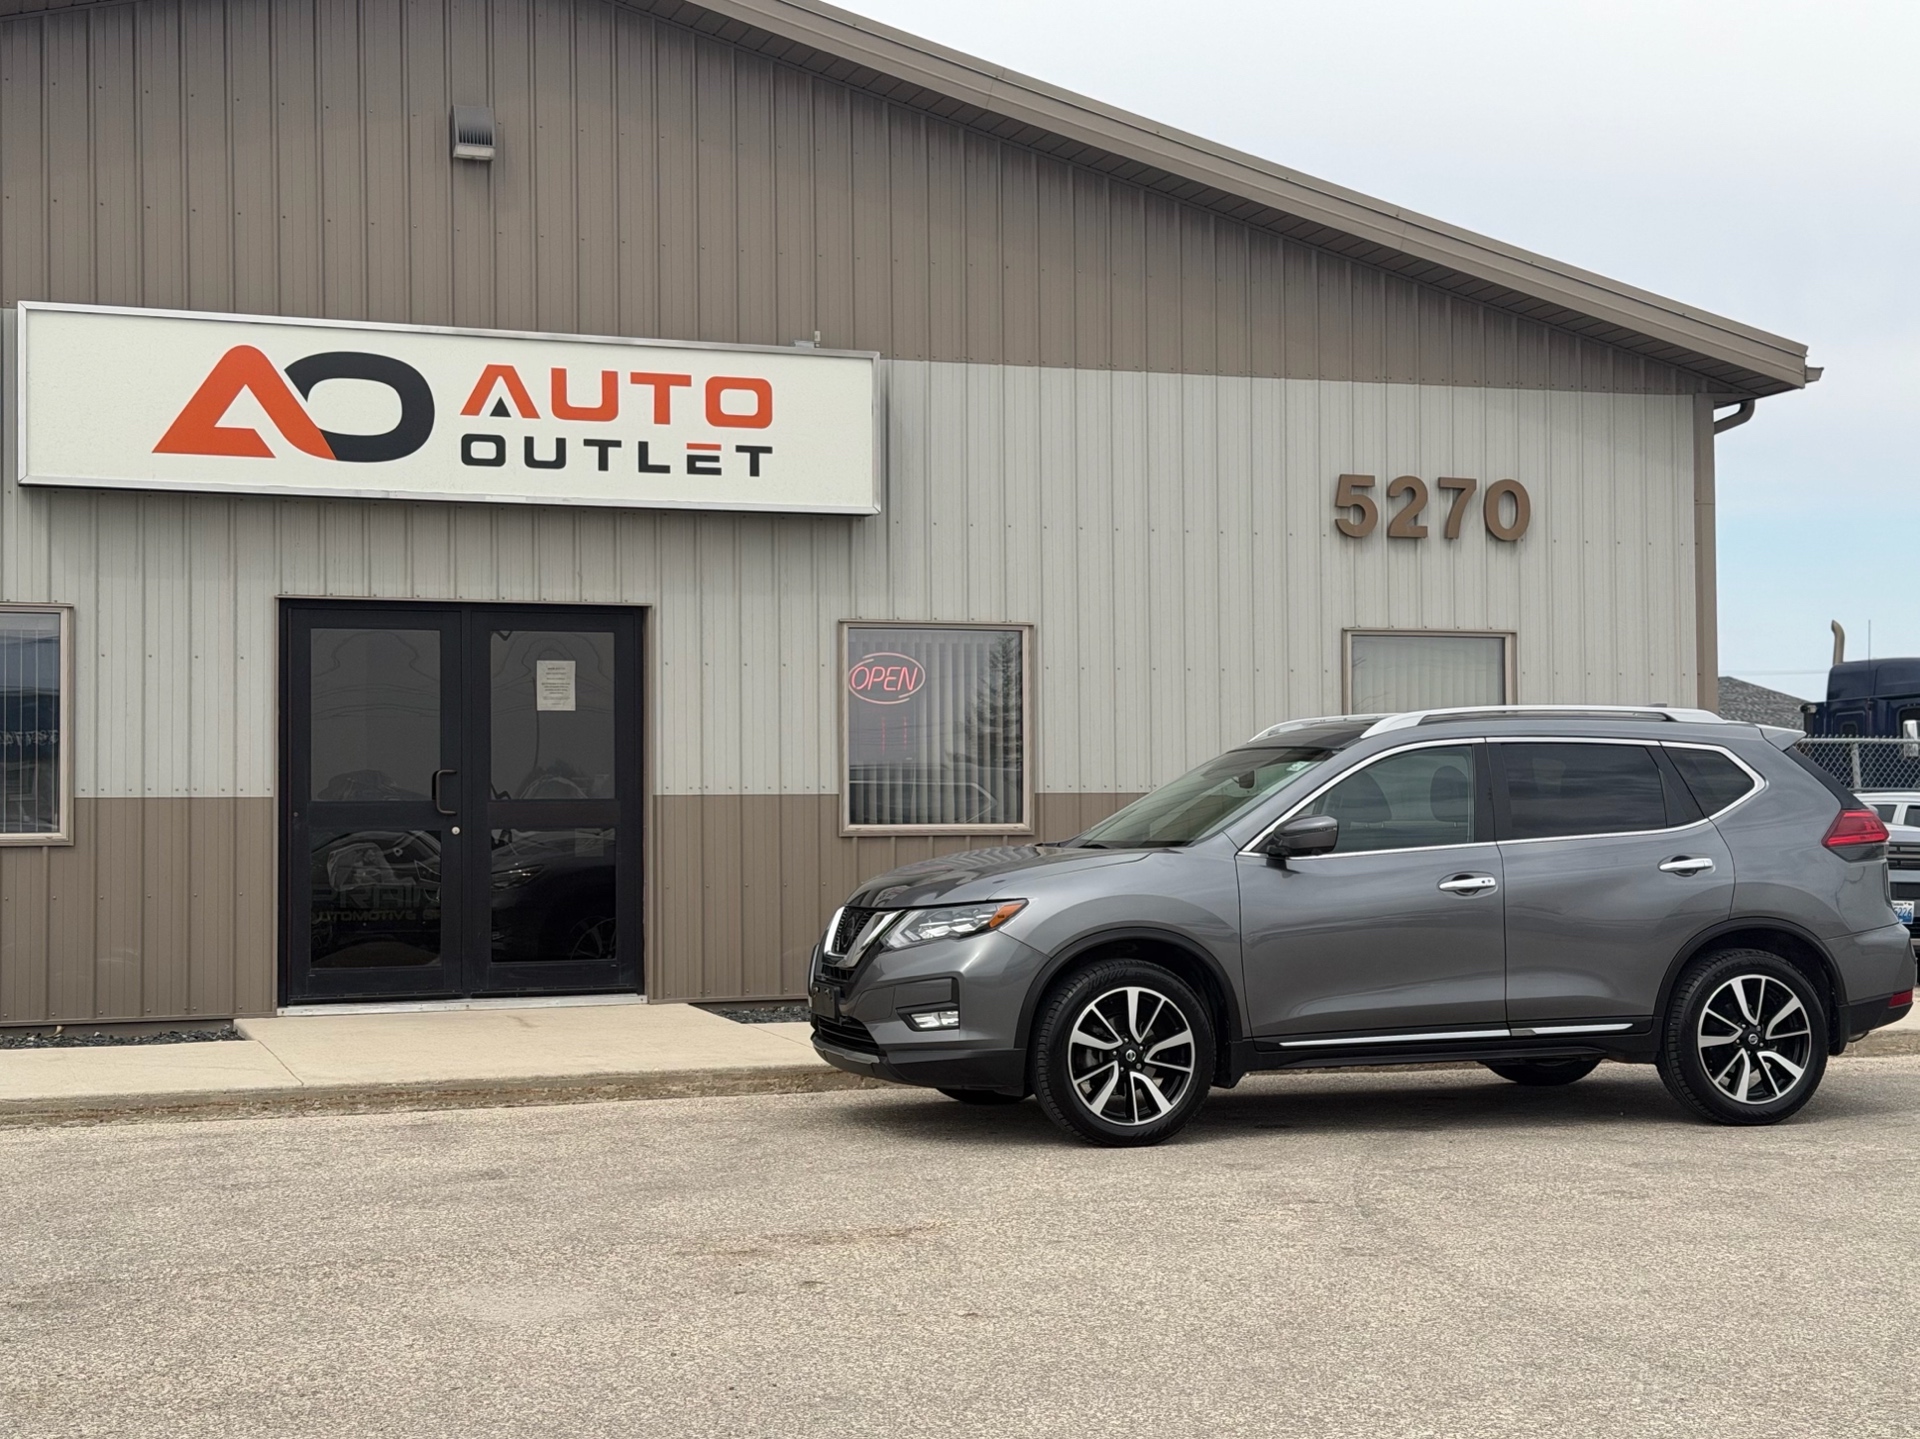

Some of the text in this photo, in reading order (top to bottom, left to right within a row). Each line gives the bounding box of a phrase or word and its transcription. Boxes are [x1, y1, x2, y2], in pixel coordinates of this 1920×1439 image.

[153, 345, 435, 462] AO
[461, 363, 774, 429] AUTO
[461, 433, 774, 477] OUTLET
[1335, 474, 1531, 541] 5270
[851, 666, 918, 691] OPEN
